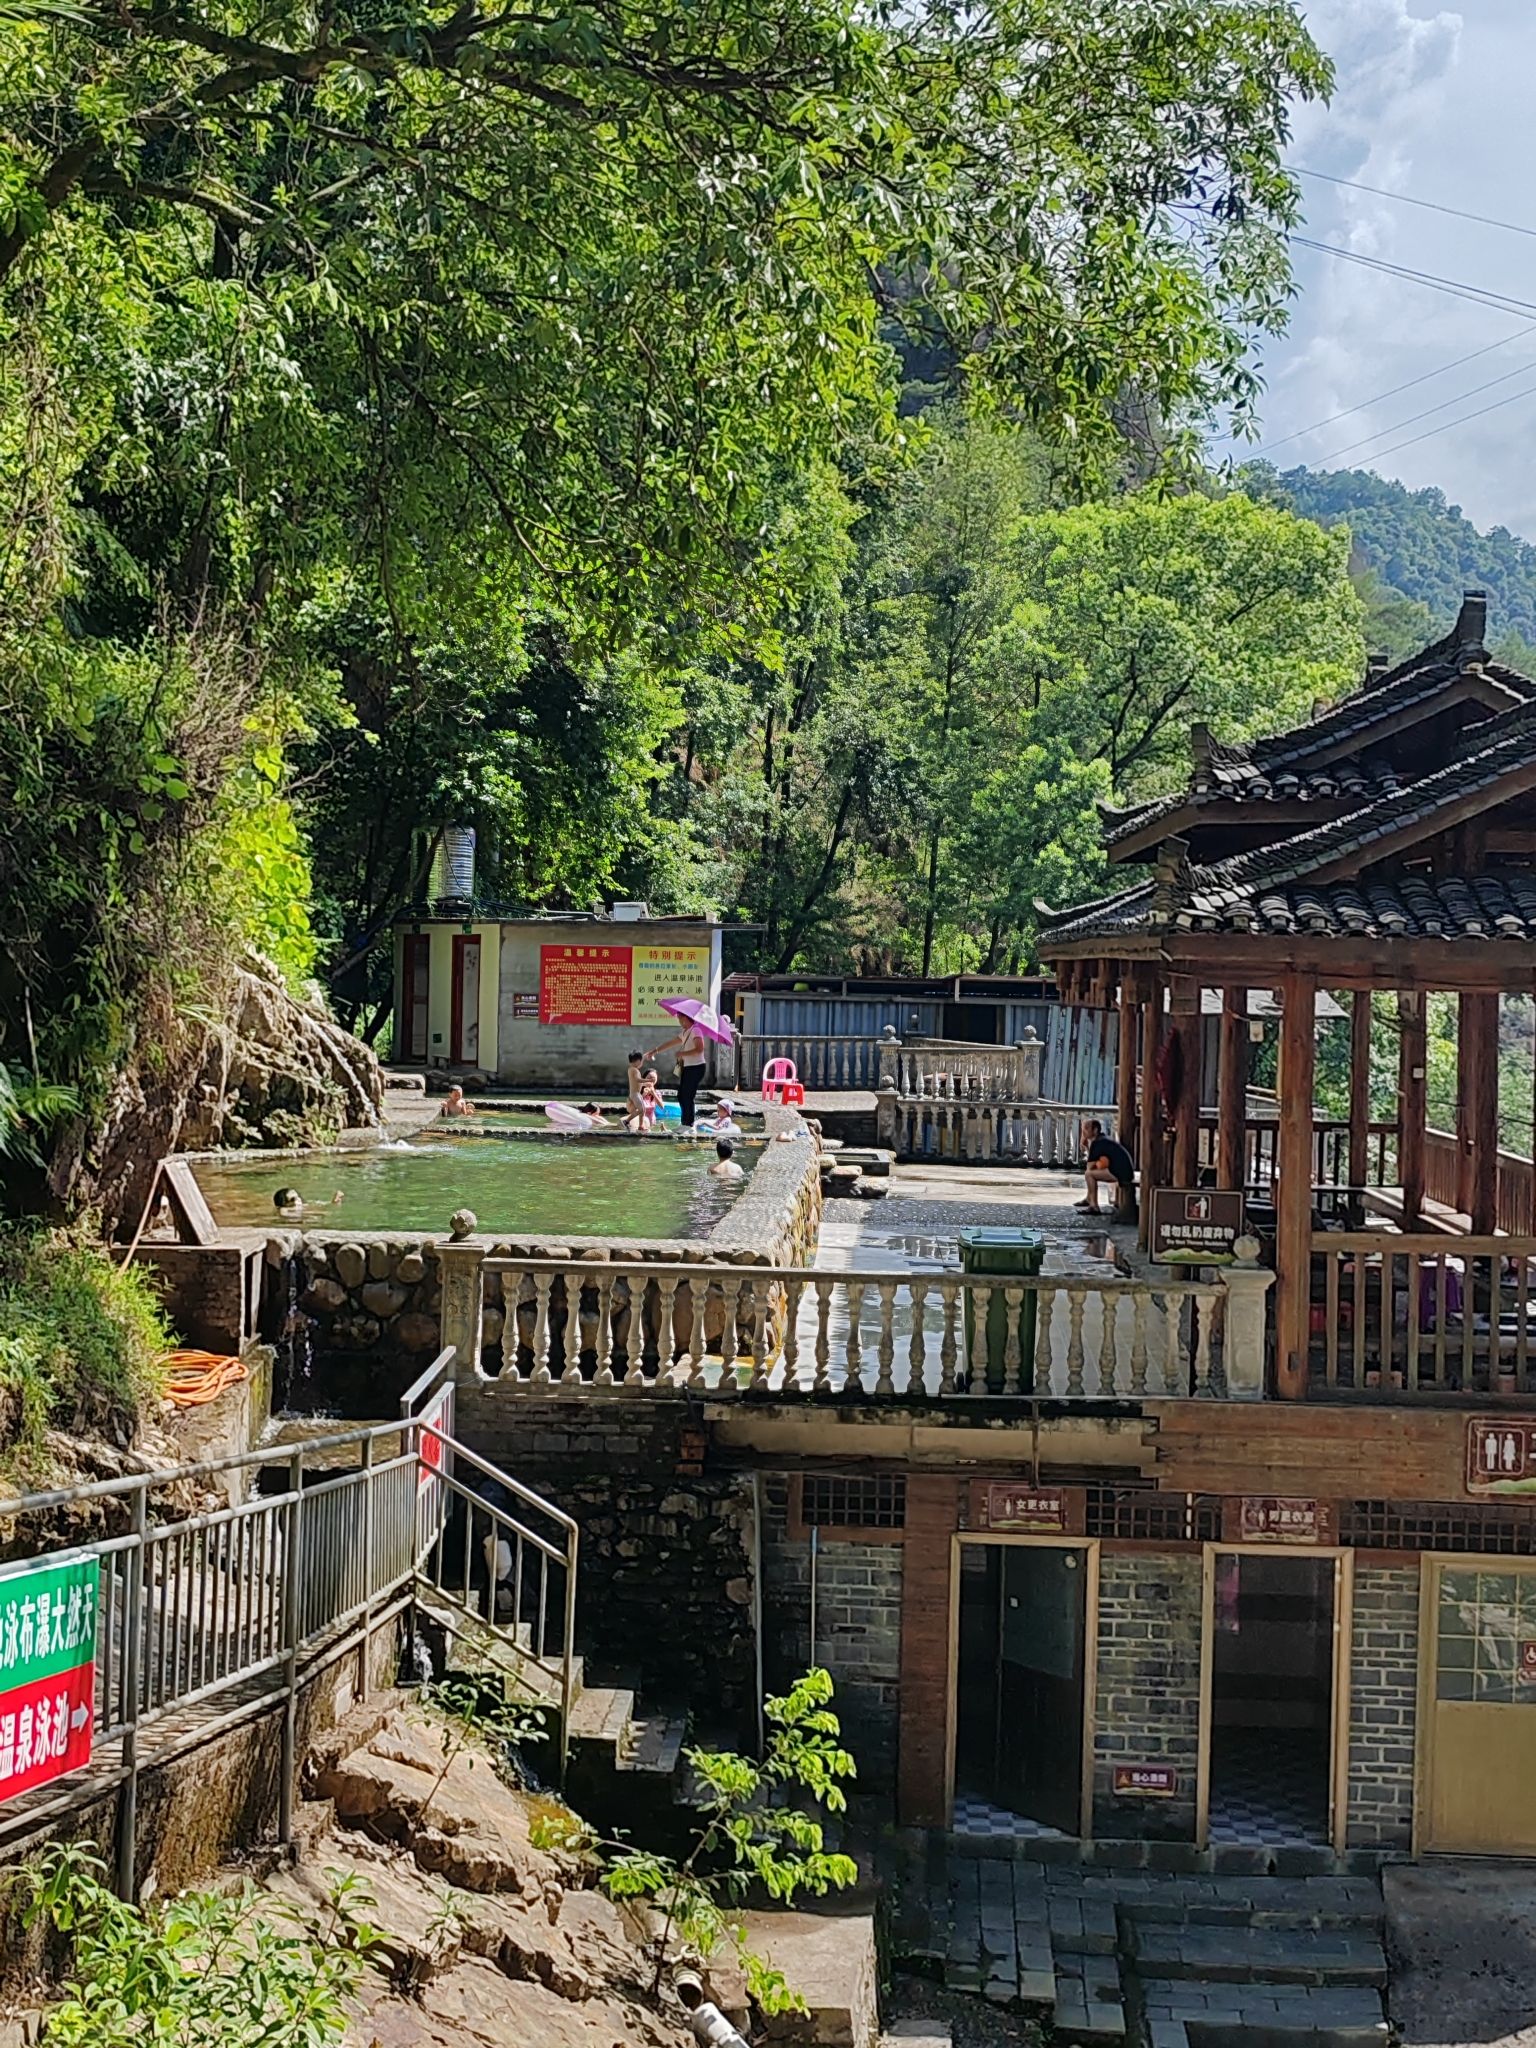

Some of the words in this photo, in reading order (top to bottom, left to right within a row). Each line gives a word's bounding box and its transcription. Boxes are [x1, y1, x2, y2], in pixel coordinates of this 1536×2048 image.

[564, 948, 610, 958] 温馨提示
[648, 950, 697, 961] 特别提示
[654, 973, 703, 982] 进入温泉泳池
[1160, 1224, 1235, 1240] 请勿乱扔废弃物
[1016, 1499, 1060, 1511] 女更衣室
